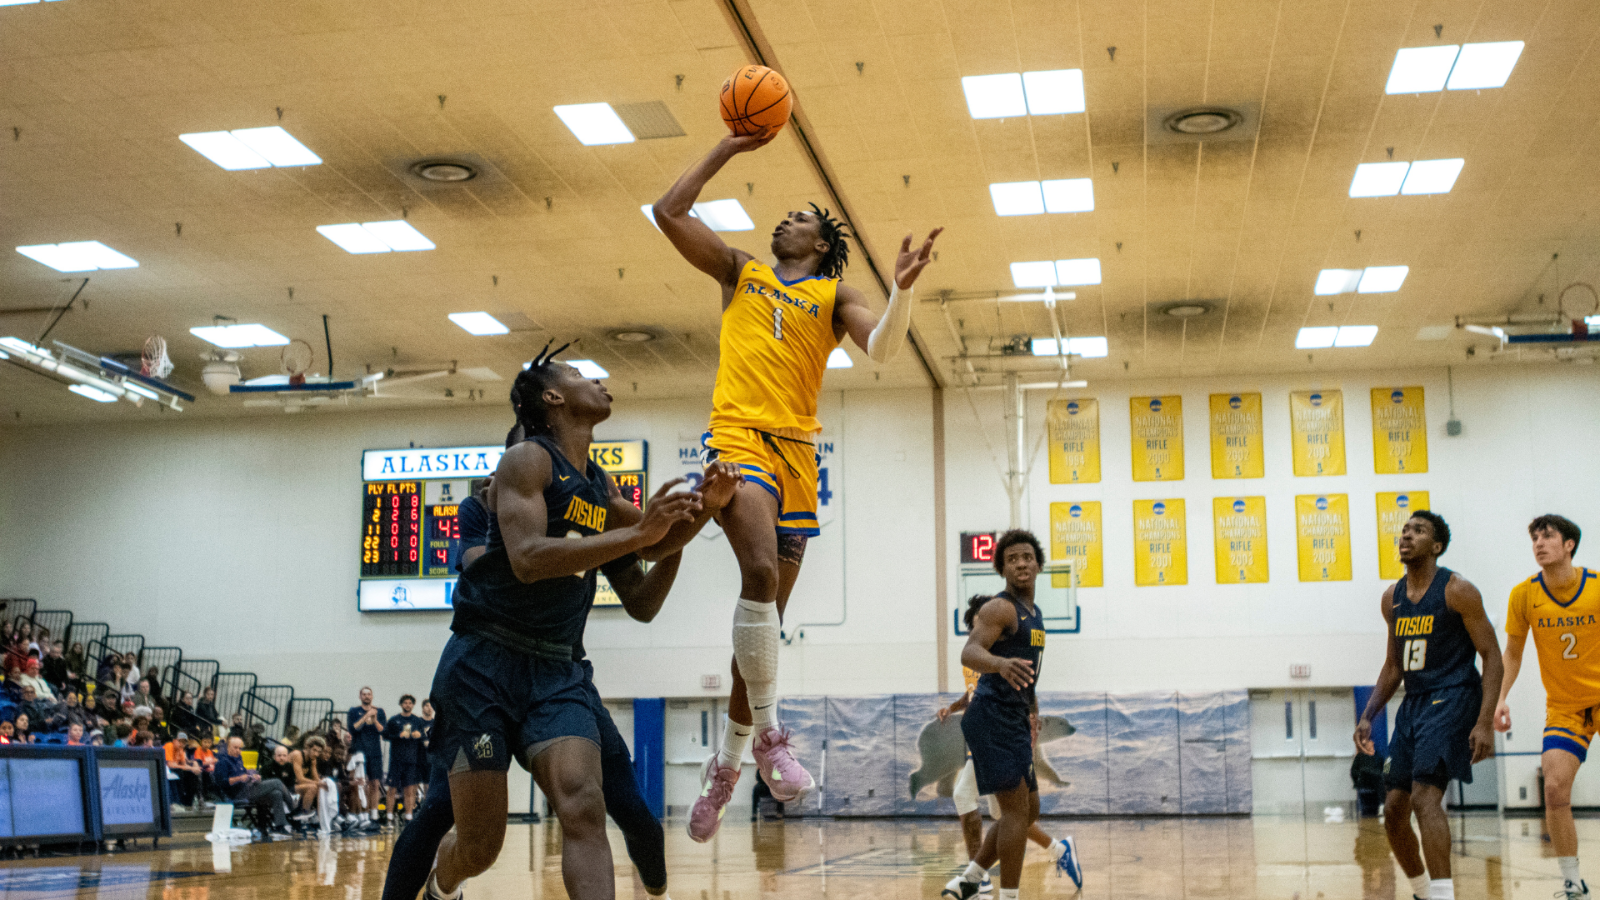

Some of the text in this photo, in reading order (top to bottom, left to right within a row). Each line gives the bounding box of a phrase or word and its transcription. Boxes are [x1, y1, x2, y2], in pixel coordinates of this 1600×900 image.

[745, 282, 820, 319] ALASKA
[772, 307, 783, 340] 1
[1215, 412, 1256, 424] NATIONAL
[1376, 406, 1420, 419] NATIONAL
[1135, 415, 1178, 427] NATIONAL
[1226, 436, 1247, 448] RIFLE
[1307, 433, 1328, 445] RIFLE
[1388, 431, 1411, 442] RIFLE
[1063, 442, 1084, 452] RIFLE
[1146, 439, 1168, 450] RIFLE
[380, 452, 490, 474] ALASKA
[620, 475, 638, 486] PTS
[368, 483, 416, 494] PLY FL PTS
[633, 487, 641, 500] 2
[377, 495, 418, 508] 1 0 8
[372, 508, 418, 522] 2 2 6
[433, 505, 459, 516] ALASK
[564, 495, 607, 533] MSUB
[1139, 518, 1180, 530] NATIONAL
[1219, 515, 1261, 528] NATIONAL
[1301, 513, 1344, 525] NATIONAL
[368, 522, 418, 535] 11 0 4
[1055, 521, 1097, 533] NATIONAL
[1302, 526, 1345, 537] CHAMPIONS
[1057, 533, 1098, 543] CHAMPIONS
[1140, 530, 1181, 541] CHAMPIONS
[1220, 528, 1262, 539] CHAMPIONS
[364, 535, 417, 549] 22 0 0
[430, 540, 449, 548] FOULS
[973, 535, 992, 560] 12
[1149, 543, 1171, 553] RIFLE
[1230, 540, 1252, 551] RIFLE
[1312, 538, 1335, 549] RIFLE
[363, 550, 379, 563] 23
[410, 549, 417, 562] 0
[437, 549, 447, 563] 4
[1066, 545, 1087, 556] RIFLE
[429, 567, 448, 575] SCORE
[1395, 615, 1434, 636] MSUB
[1537, 615, 1596, 628] ALASKA
[1560, 633, 1579, 660] 2
[1403, 639, 1427, 671] 13
[103, 774, 148, 802] Alaska
